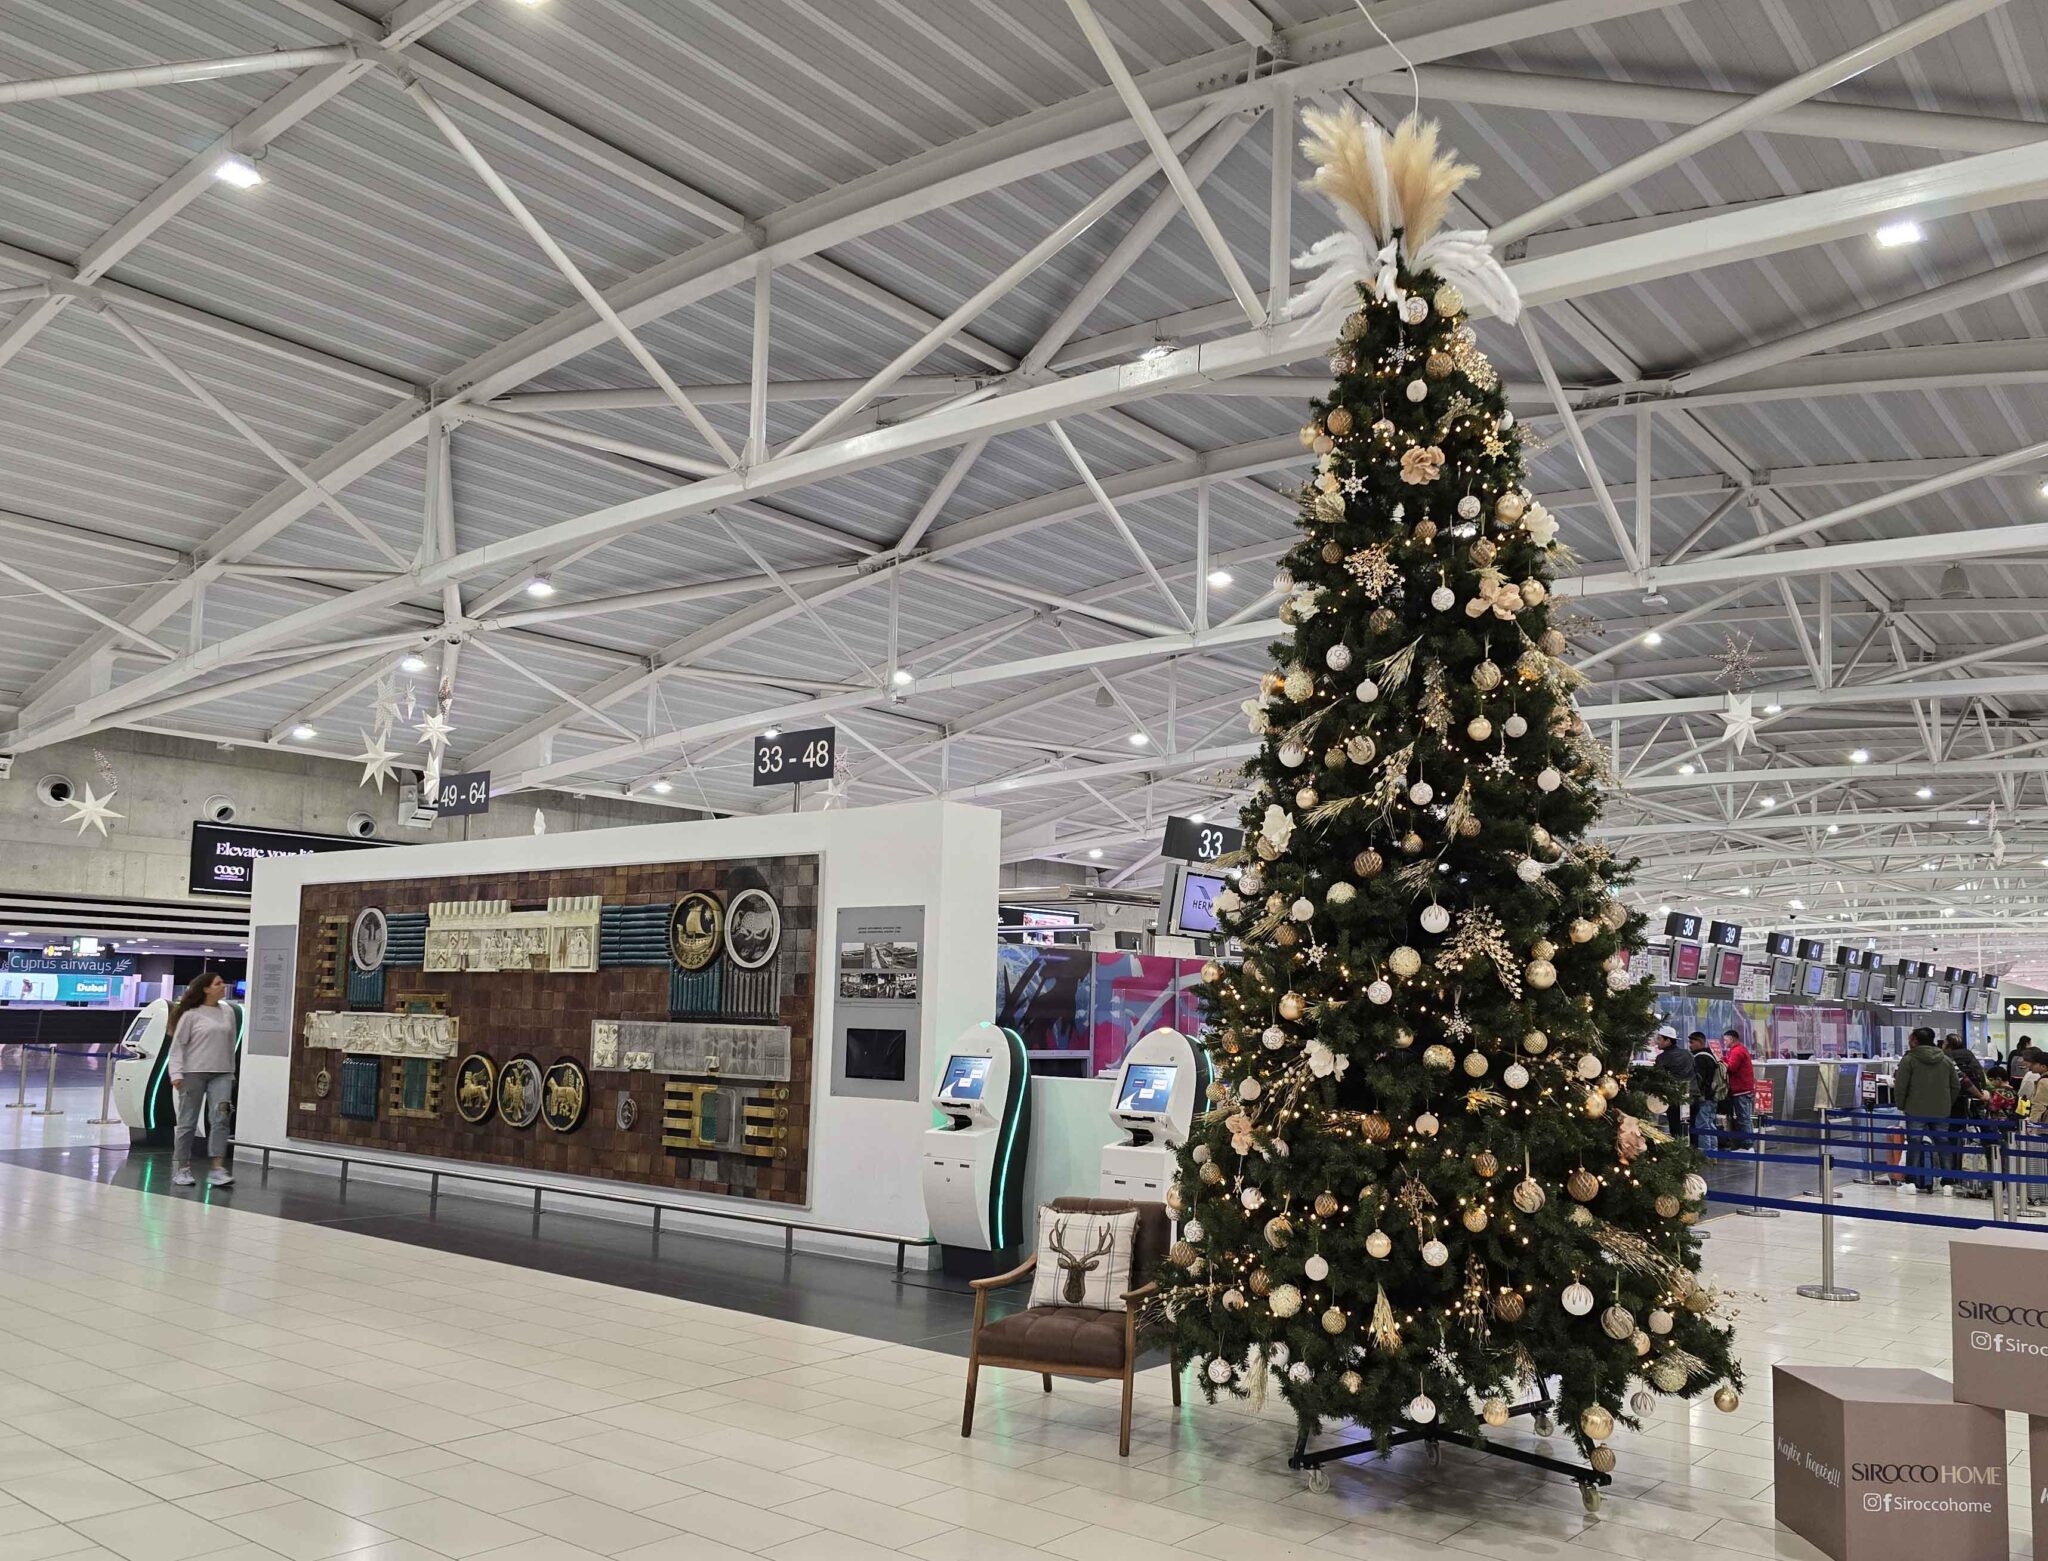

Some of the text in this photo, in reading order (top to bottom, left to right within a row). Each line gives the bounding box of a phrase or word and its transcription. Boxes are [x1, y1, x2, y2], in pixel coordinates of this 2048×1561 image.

[758, 745, 783, 774] 33
[802, 740, 829, 768] 48
[440, 784, 457, 807] 49
[469, 781, 486, 805] 64
[216, 842, 265, 858] Elevate
[1198, 829, 1223, 859] 33
[1192, 900, 1213, 910] HERM
[1683, 918, 1695, 936] 38
[1725, 926, 1736, 944] 39
[1780, 938, 1790, 954] 40
[1811, 944, 1820, 959] 41
[10, 955, 57, 972] Cyprus
[60, 959, 112, 974] airways
[77, 982, 108, 992] Dubai
[1941, 1465, 2002, 1486] HOME
[1894, 1497, 1992, 1513] Siroccohome
